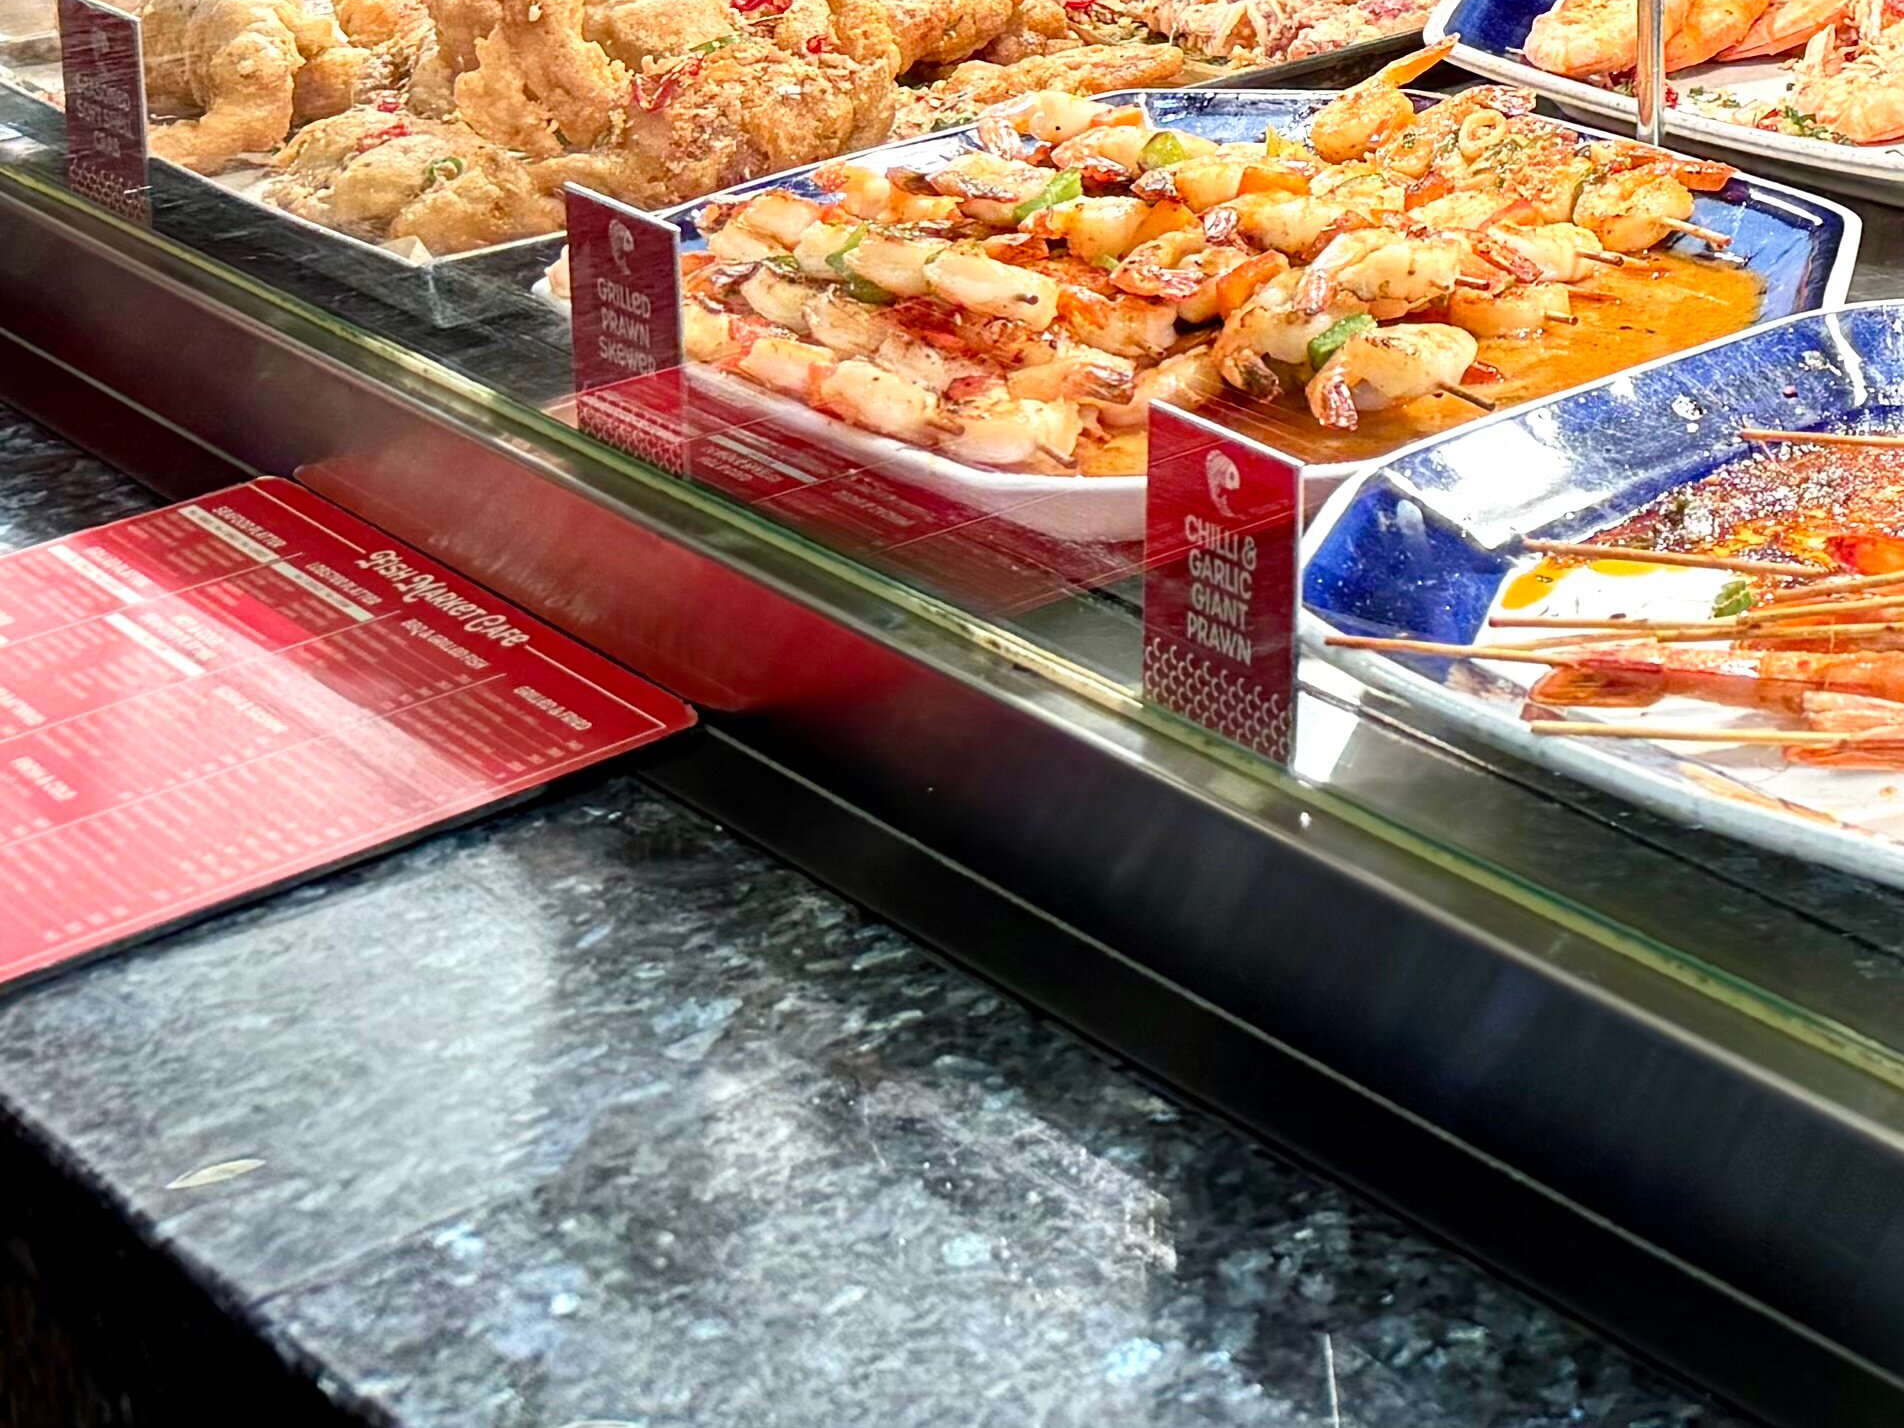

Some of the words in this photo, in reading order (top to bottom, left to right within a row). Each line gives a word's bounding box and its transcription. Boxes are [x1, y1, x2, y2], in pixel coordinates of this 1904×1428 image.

[601, 307, 650, 348] PRAWN
[1185, 514, 1238, 561] CHILLI
[1242, 536, 1257, 571] &
[1189, 548, 1252, 599] GARLIC
[1192, 583, 1249, 630] GIANT
[1187, 612, 1251, 665] PRAWN
